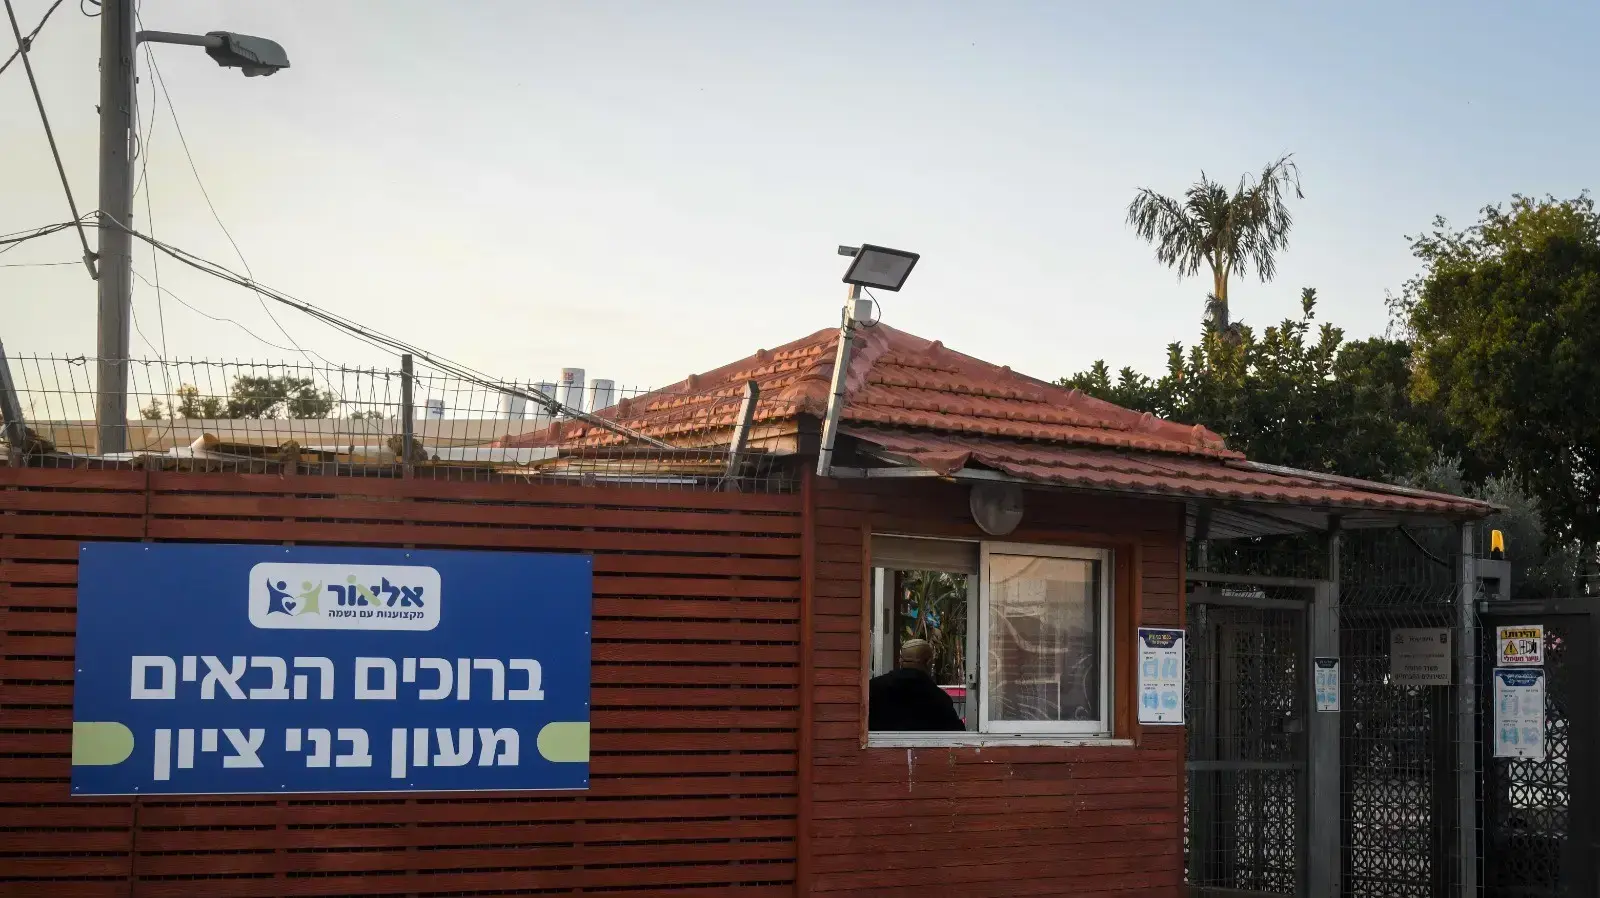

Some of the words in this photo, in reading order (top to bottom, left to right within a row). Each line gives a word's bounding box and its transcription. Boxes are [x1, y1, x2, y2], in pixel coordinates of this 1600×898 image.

[328, 609, 357, 618] נשמה
[359, 610, 374, 619] עם
[376, 610, 425, 621] מקצוענות
[1504, 630, 1536, 638] זהירות!
[130, 655, 335, 700] הבאים
[354, 656, 545, 701] ברוכים
[153, 728, 266, 781] ציון
[285, 728, 373, 768] בני
[391, 727, 520, 779] מעון
